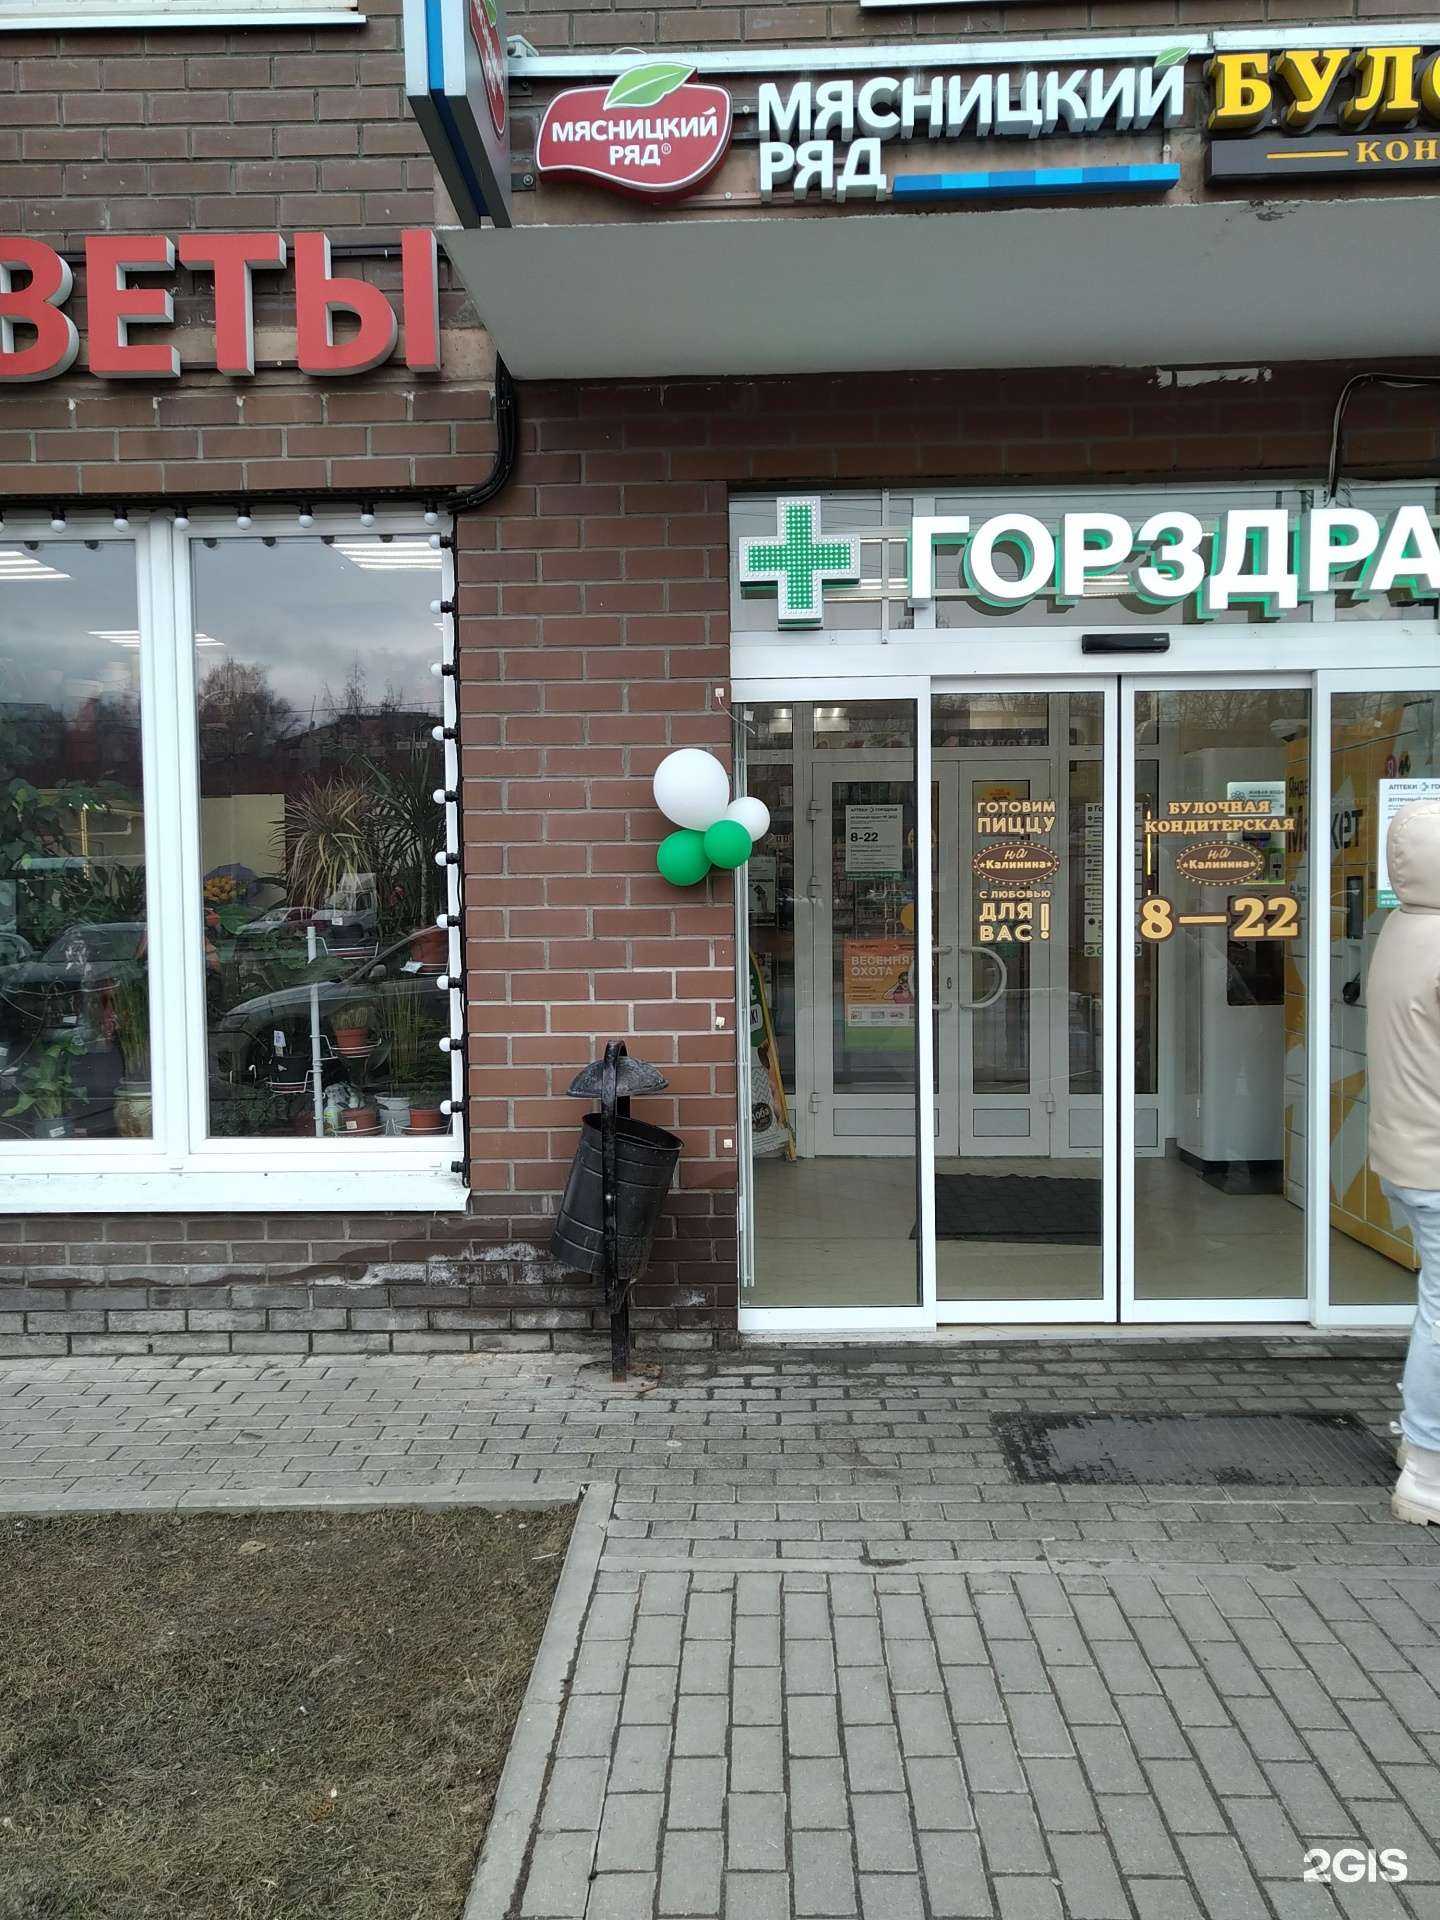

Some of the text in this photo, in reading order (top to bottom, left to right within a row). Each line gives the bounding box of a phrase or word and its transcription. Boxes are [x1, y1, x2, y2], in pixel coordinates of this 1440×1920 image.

[1210, 46, 1440, 125] БУЛ
[758, 56, 1187, 140] МЯСНИЦКИЙ
[552, 106, 718, 142] МЯСНИЦКИЙ
[759, 137, 888, 198] РЯД
[977, 801, 1056, 813] ГОТОВИМ
[1169, 801, 1271, 814] БУЛОЧНАЯ
[977, 816, 1056, 834] ПИЦЦУ
[1144, 818, 1296, 835] КОНДИТЕРСКАЯ
[850, 832, 879, 842] 8-22
[986, 859, 1047, 869] Калинина
[1189, 859, 1250, 870] Калинина
[979, 902, 1033, 922] ДЛЯ
[851, 967, 893, 976] ОХОТА
